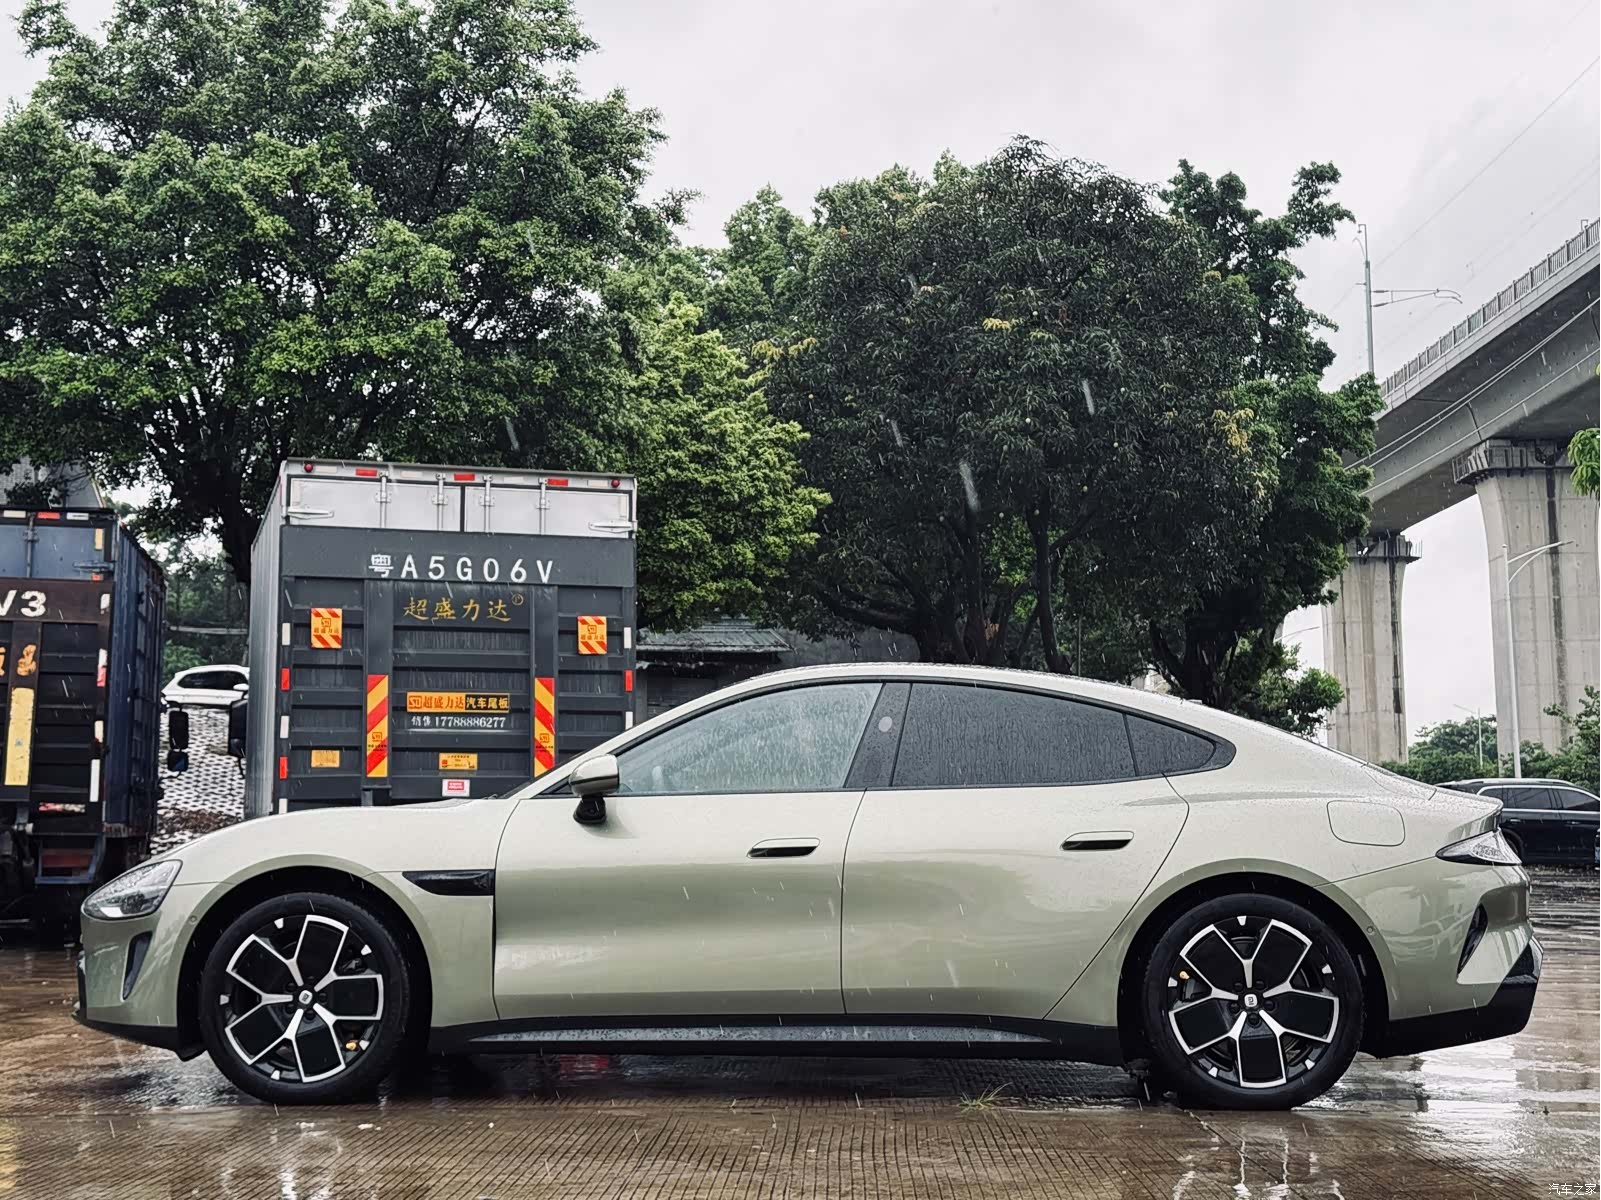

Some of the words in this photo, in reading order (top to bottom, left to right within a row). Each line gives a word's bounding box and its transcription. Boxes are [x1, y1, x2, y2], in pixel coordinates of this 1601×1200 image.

[368, 554, 553, 584] 粤A5G06V
[403, 597, 511, 622] 超盛力达
[466, 697, 509, 709] 汽车尾板
[435, 717, 506, 728] 17788886277
